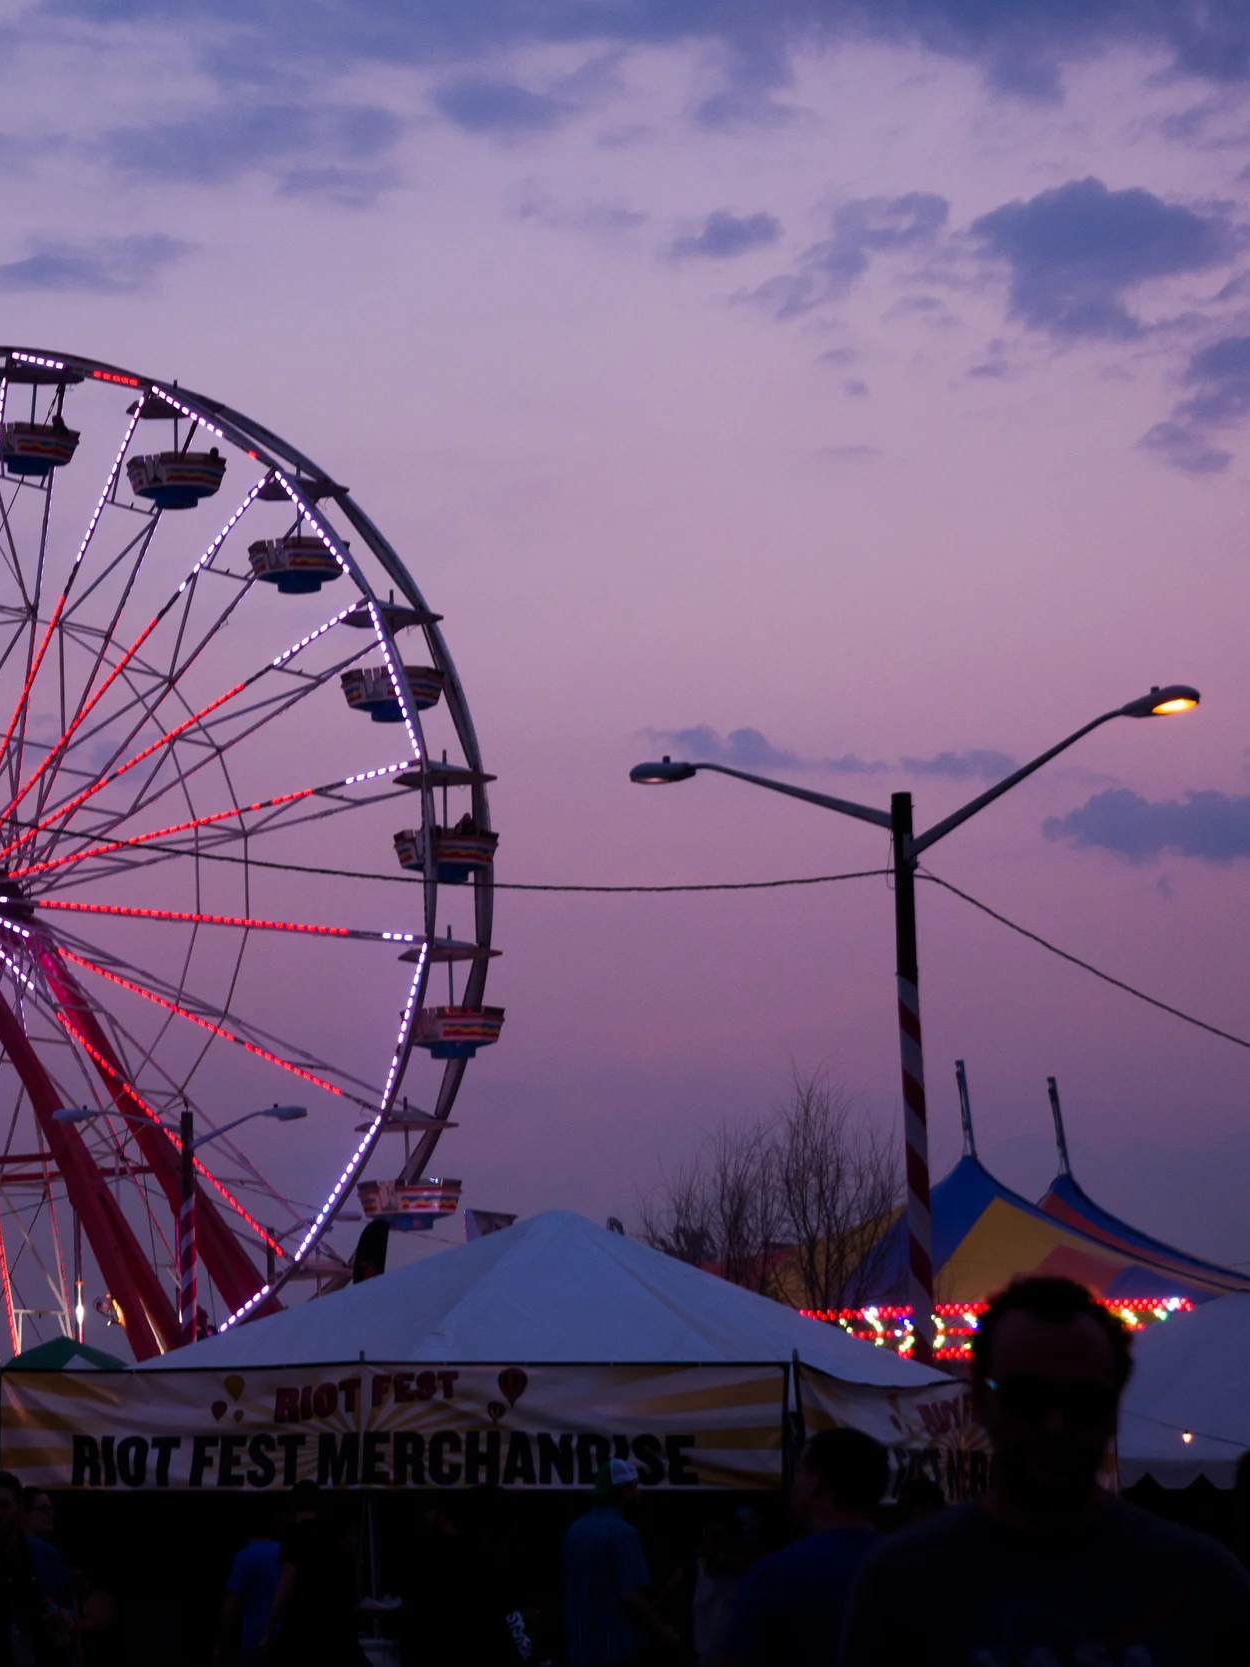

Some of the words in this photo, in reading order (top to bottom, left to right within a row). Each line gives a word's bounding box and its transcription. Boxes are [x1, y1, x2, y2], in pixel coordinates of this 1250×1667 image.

[275, 1378, 361, 1423] RIOT
[372, 1370, 459, 1406] FEST
[72, 1435, 180, 1486] RIOT
[189, 1435, 306, 1486] FEST
